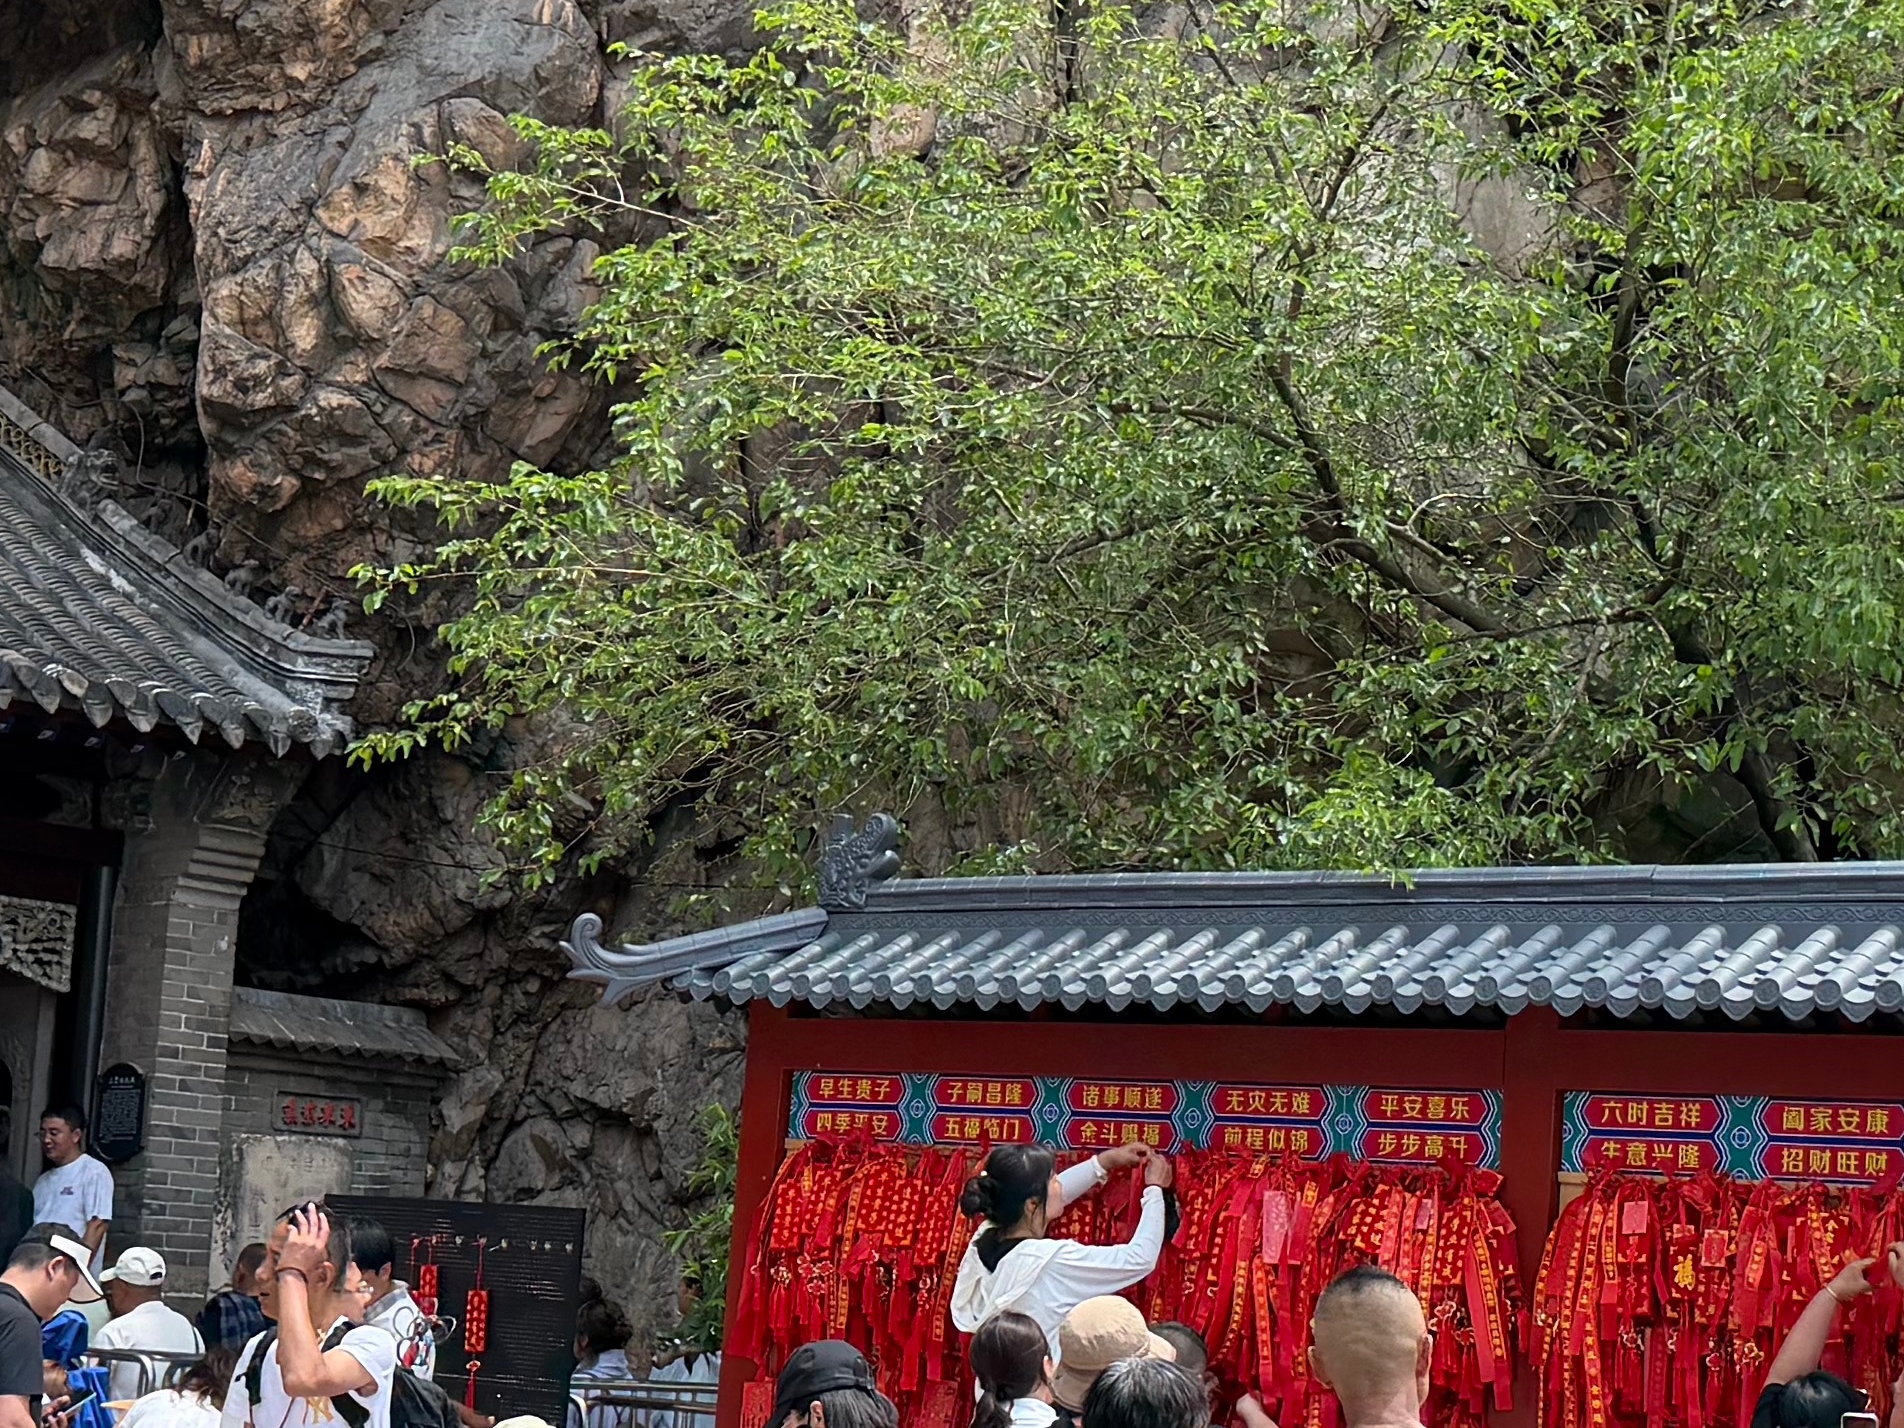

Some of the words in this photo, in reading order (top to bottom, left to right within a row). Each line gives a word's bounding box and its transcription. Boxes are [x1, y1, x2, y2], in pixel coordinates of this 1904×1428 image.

[817, 1078, 892, 1101] 早生贵子
[946, 1081, 1024, 1106] 子嗣昌隆
[1082, 1084, 1165, 1110] 诸事顺遂
[1225, 1090, 1311, 1115] 无灾无难
[1379, 1093, 1471, 1120] 平安喜乐
[1601, 1101, 1702, 1128] 六时吉祥
[816, 1113, 889, 1137] 四季平安
[944, 1116, 1020, 1141] 五福临门
[1079, 1120, 1161, 1146] 金斗赐福
[1782, 1106, 1890, 1135] 阖家安康
[1224, 1126, 1309, 1152] 前程似锦
[1377, 1133, 1468, 1160] 步步高升
[1781, 1147, 1888, 1177] 招财旺财
